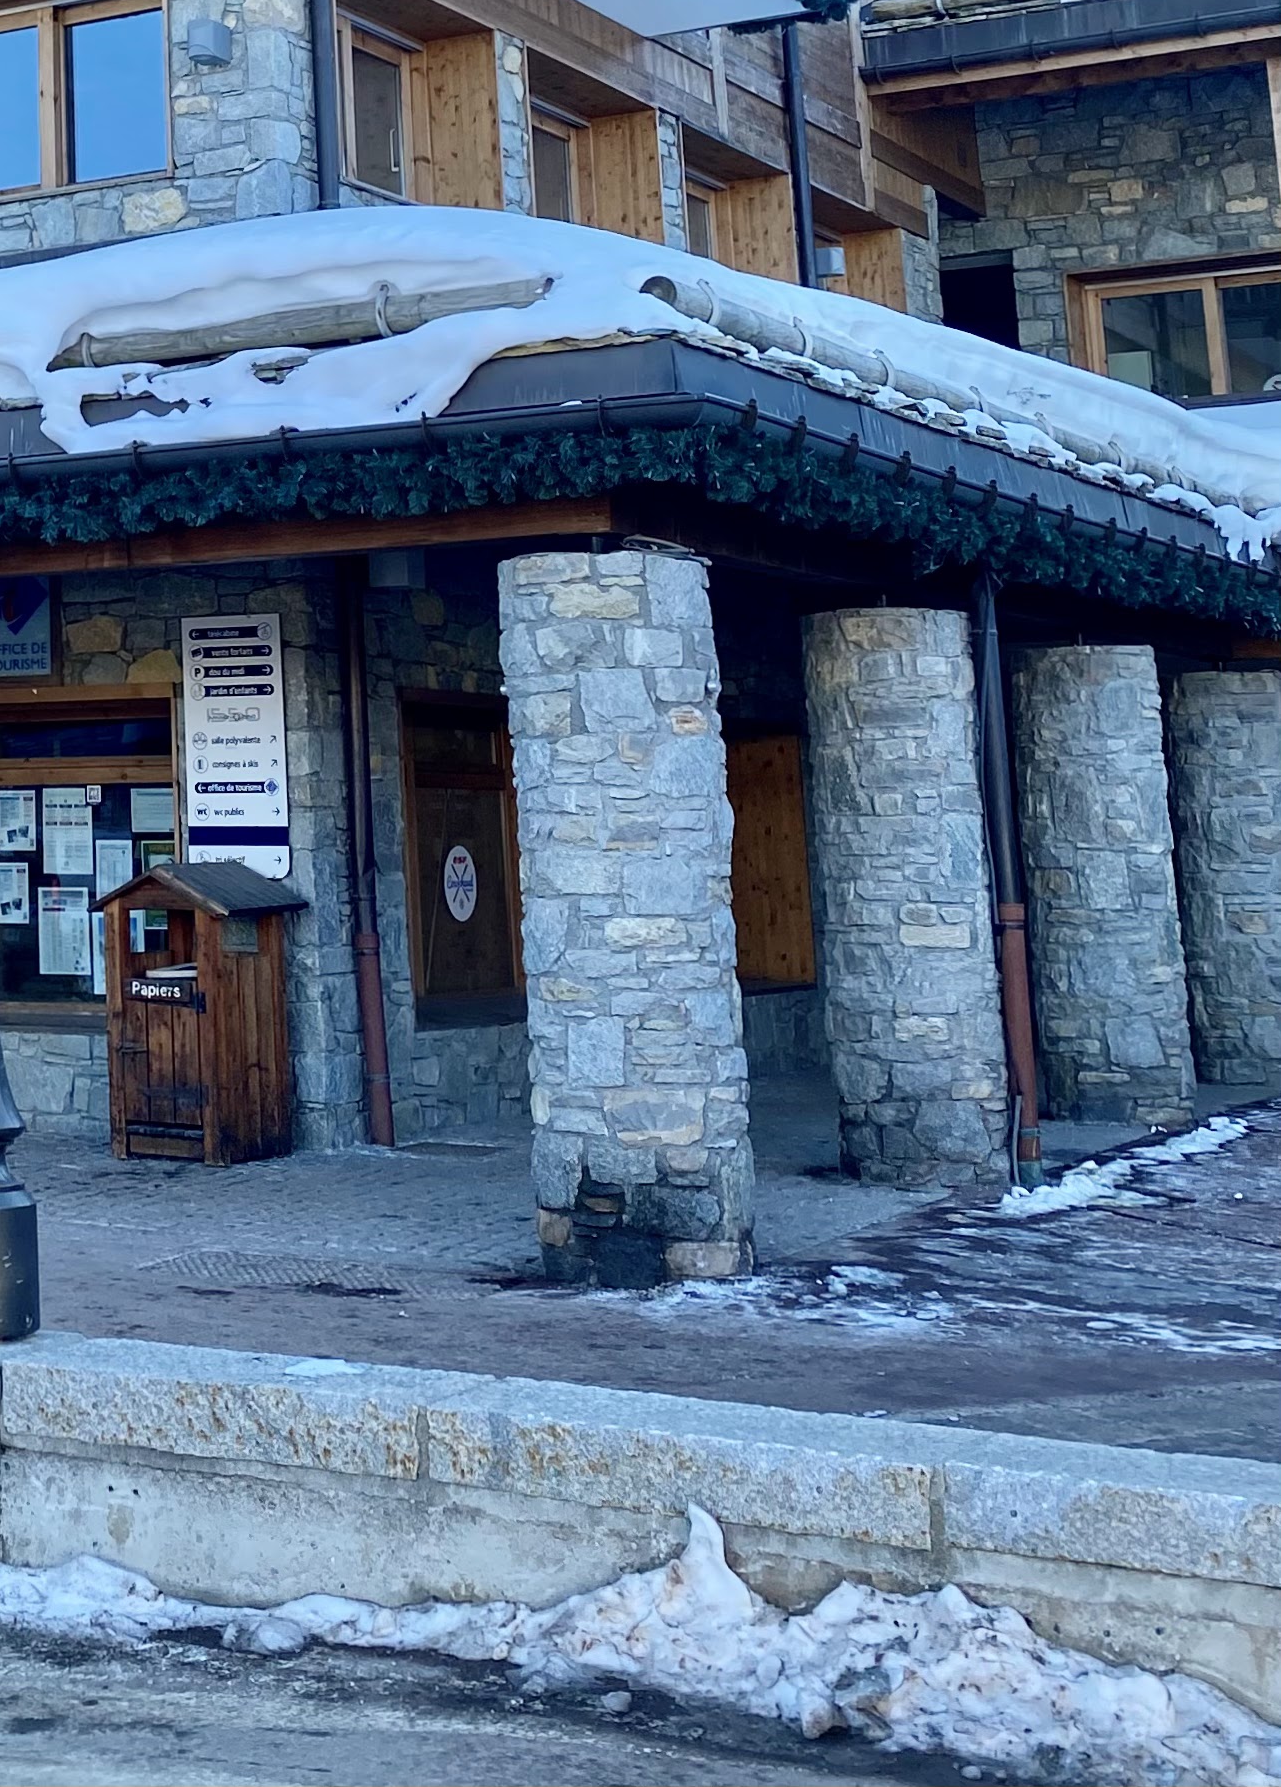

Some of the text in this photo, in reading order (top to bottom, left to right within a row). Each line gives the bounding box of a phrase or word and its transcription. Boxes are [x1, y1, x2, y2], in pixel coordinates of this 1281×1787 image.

[31, 642, 48, 654] DE
[194, 667, 201, 678] P
[211, 736, 261, 746] salle polyvalente
[212, 760, 241, 770] consignes
[247, 759, 259, 768] skis
[207, 783, 262, 792] office de tourisme
[224, 807, 245, 818] publics
[131, 980, 181, 999] Papiers
